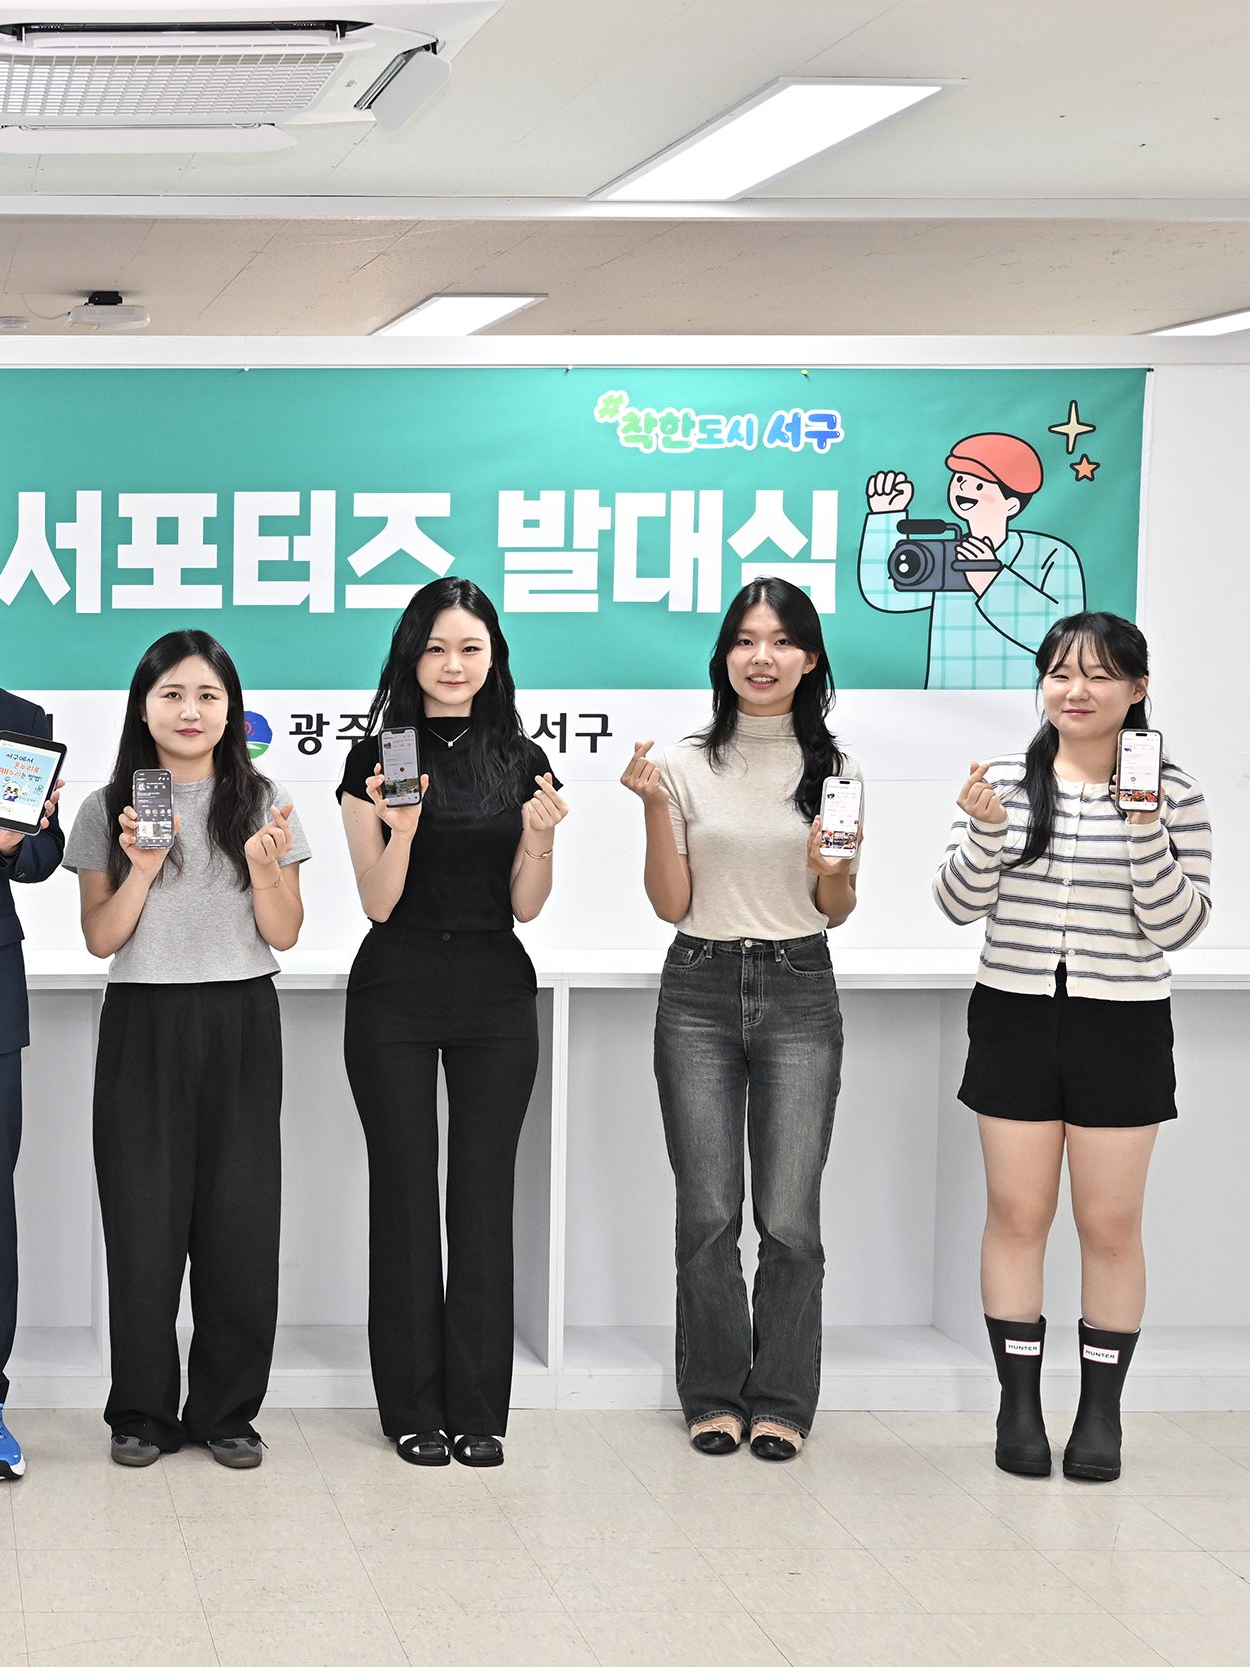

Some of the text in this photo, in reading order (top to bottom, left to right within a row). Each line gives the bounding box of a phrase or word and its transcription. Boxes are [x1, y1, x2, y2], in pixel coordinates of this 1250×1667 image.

[767, 412, 841, 450] 서구
[498, 490, 838, 613] 발대식
[531, 713, 613, 753] 서구
[5, 753, 34, 763] 서구에서
[1085, 1349, 1115, 1359] HUNTER
